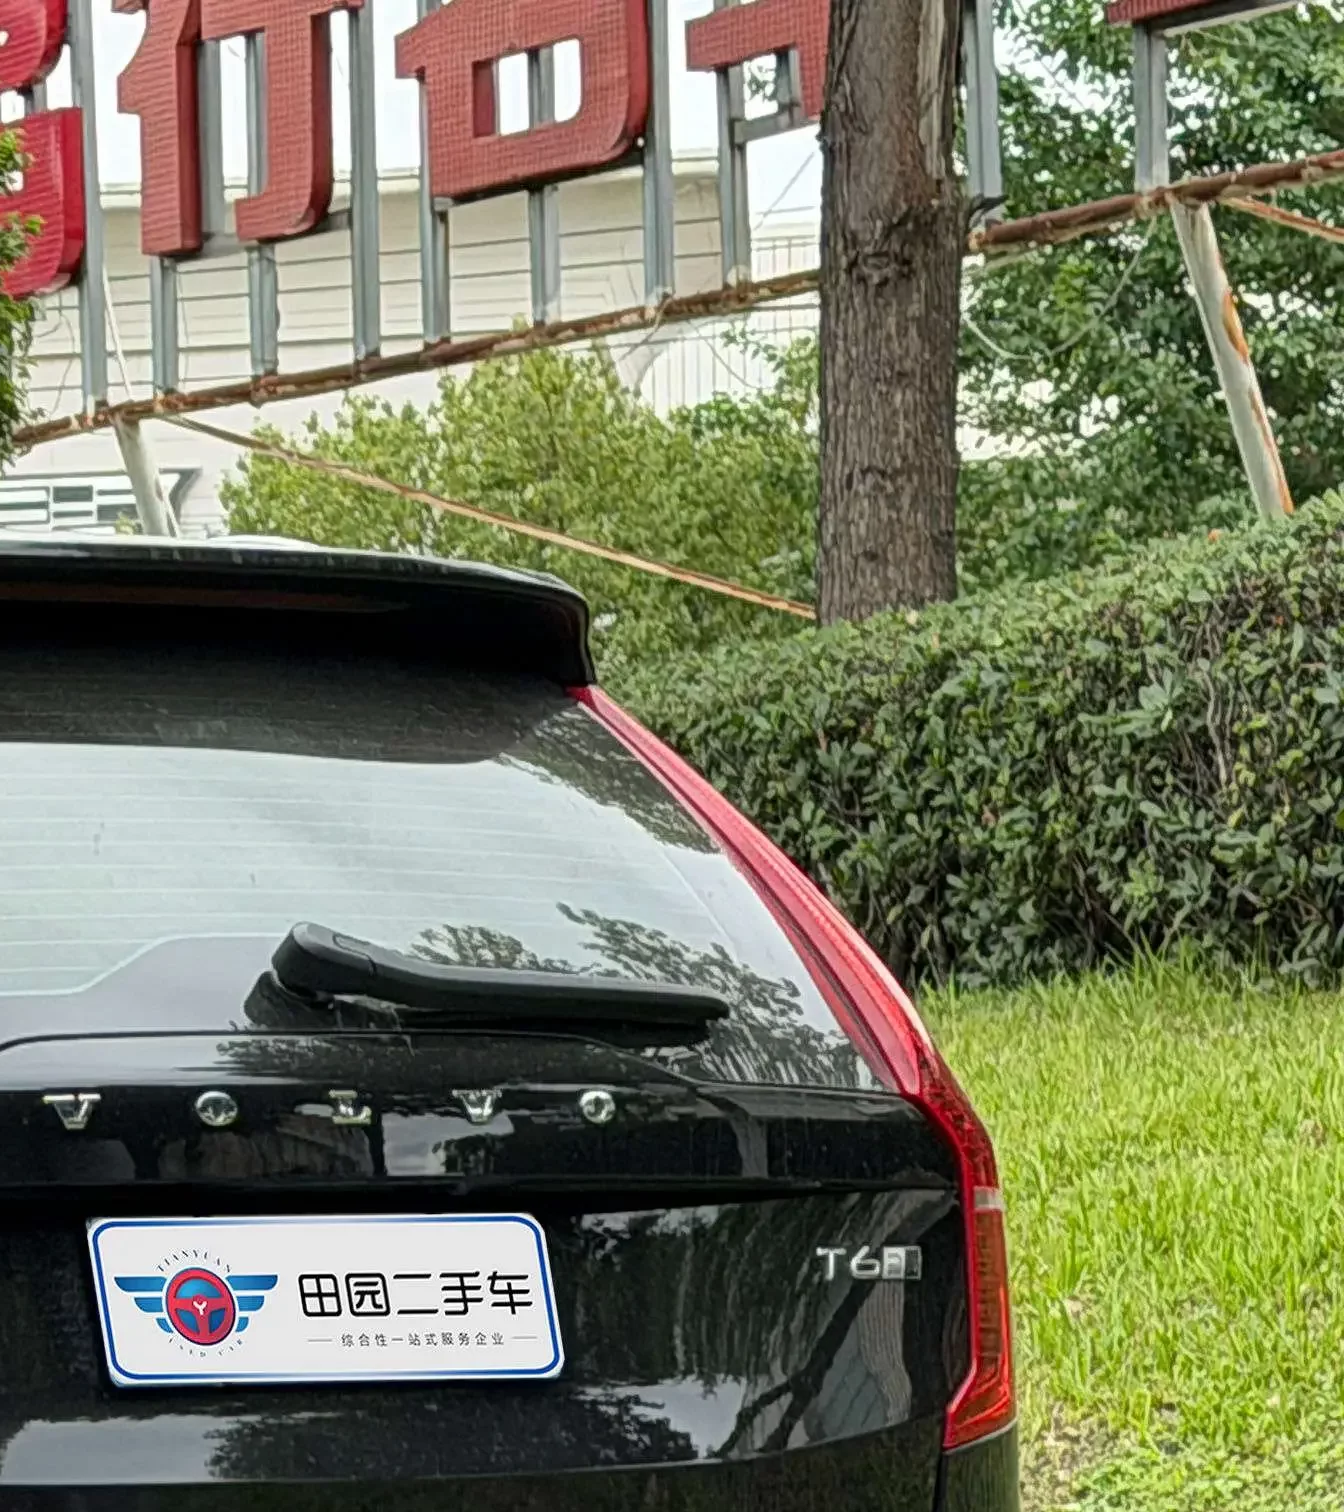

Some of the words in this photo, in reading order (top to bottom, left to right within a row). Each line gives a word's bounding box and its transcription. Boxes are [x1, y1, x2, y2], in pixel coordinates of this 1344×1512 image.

[43, 1089, 615, 1130] VOLVO
[298, 1270, 533, 1317] 田园二手车
[341, 1331, 505, 1348] 综合性一站式服务企业
